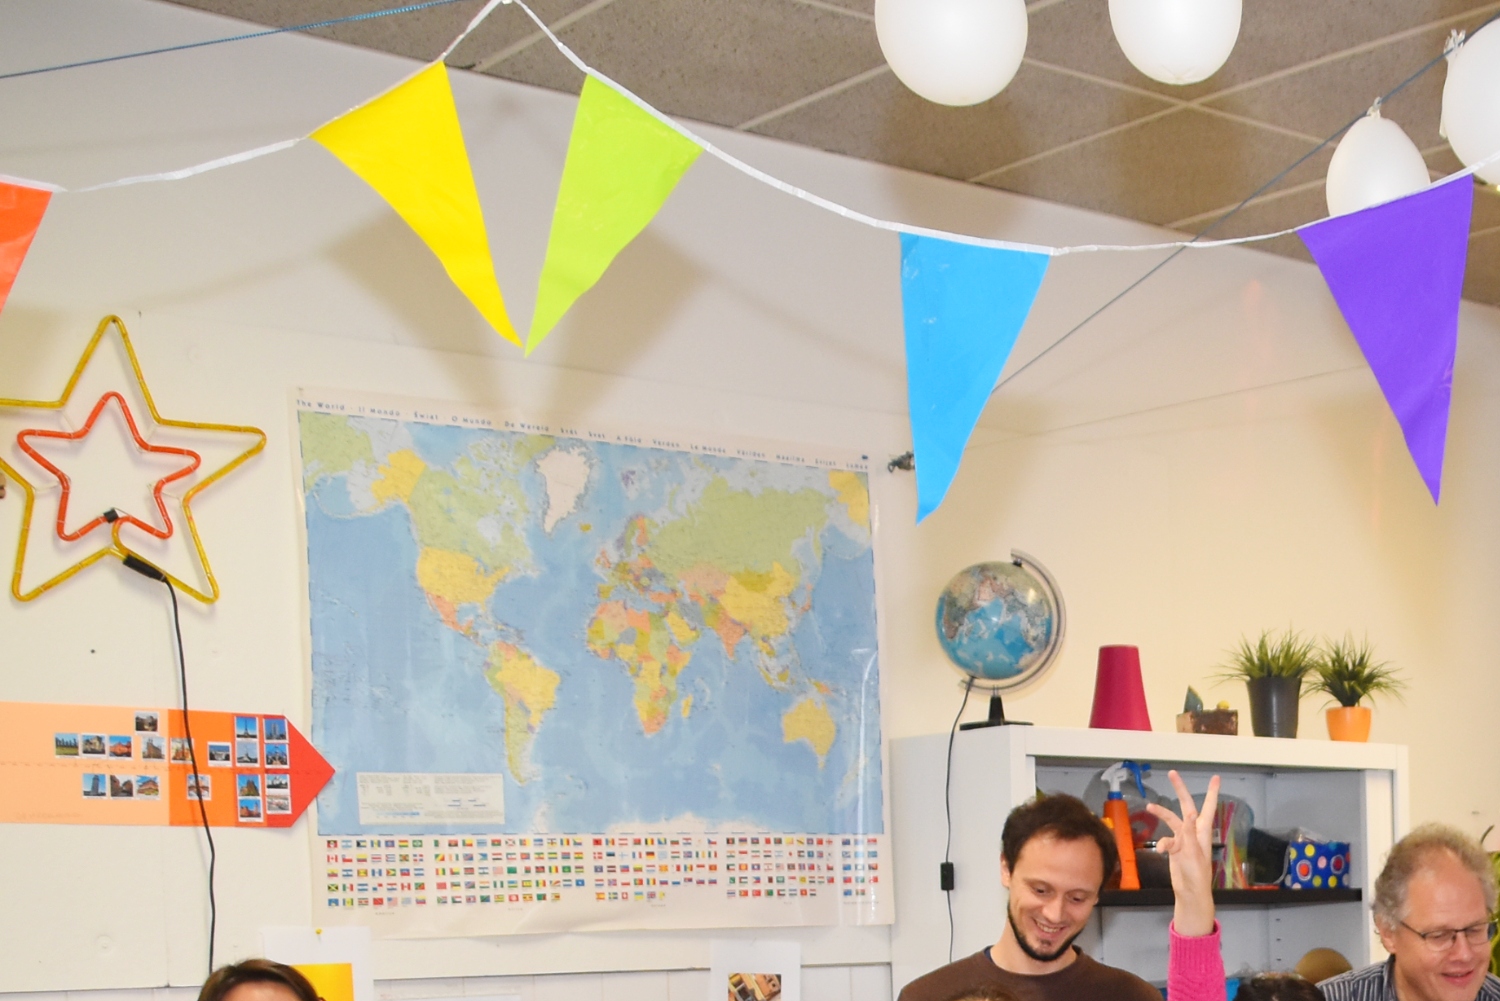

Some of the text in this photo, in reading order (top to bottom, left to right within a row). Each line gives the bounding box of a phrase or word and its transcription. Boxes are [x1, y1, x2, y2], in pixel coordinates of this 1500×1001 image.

[297, 399, 312, 408] The
[317, 402, 345, 411] World
[370, 407, 400, 416] Mondo
[462, 417, 492, 426] Mundo
